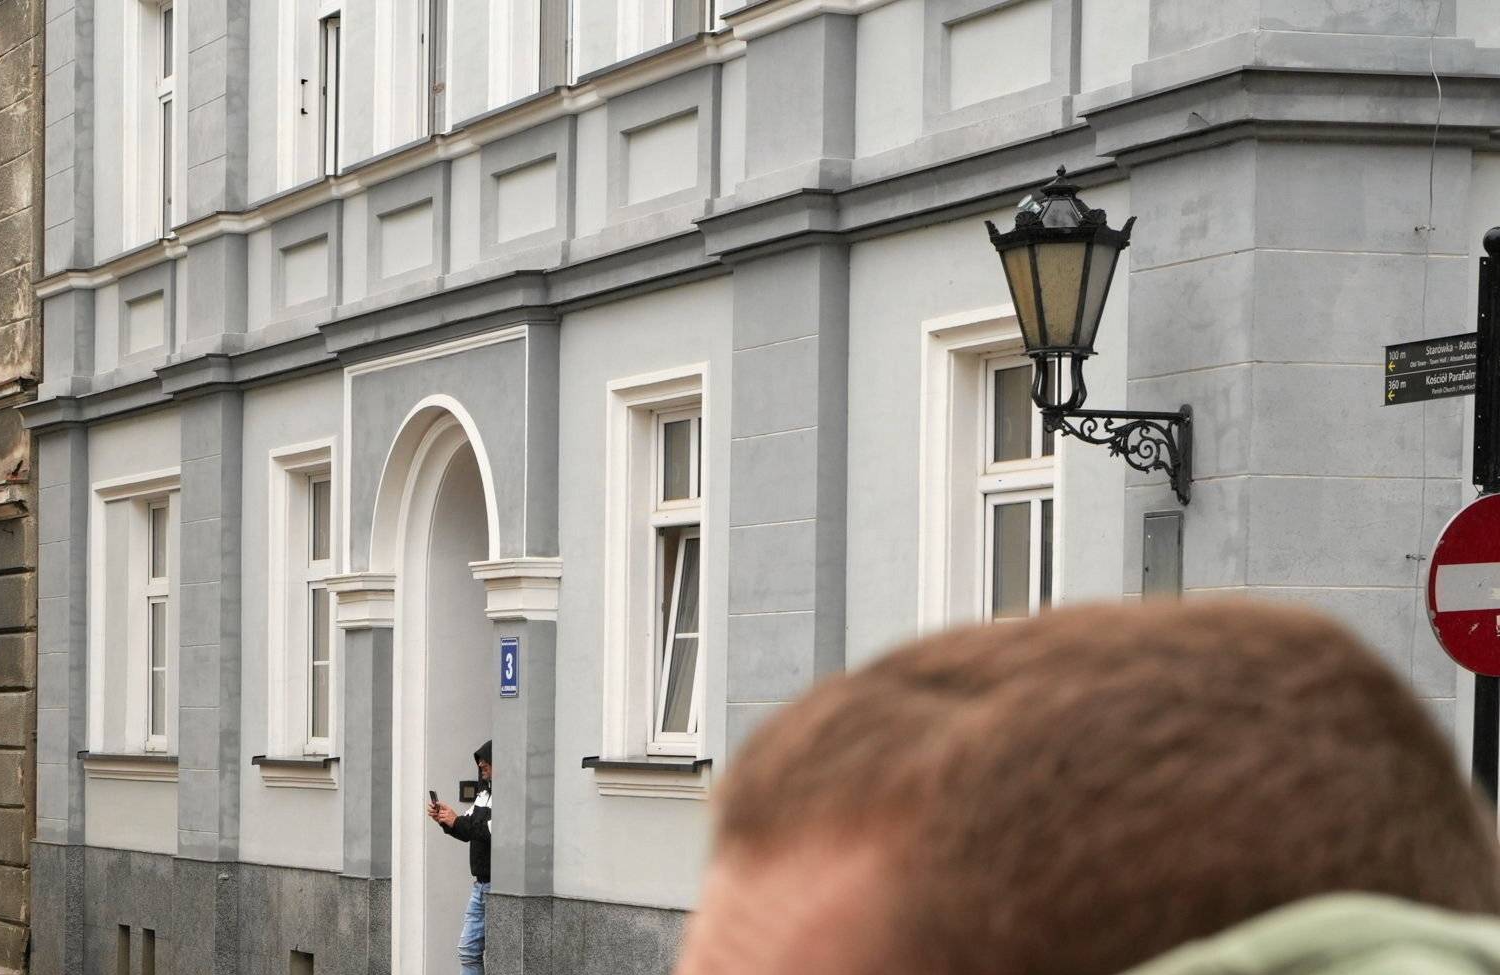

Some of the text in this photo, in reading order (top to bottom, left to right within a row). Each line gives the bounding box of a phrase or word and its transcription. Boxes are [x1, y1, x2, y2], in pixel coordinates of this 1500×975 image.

[1425, 342, 1453, 355] Starówka
[1459, 340, 1476, 350] Ratus
[1389, 351, 1406, 360] 100 m
[1425, 369, 1476, 385] Kościół Parafialn
[1388, 380, 1399, 390] 360
[505, 652, 513, 680] 3
